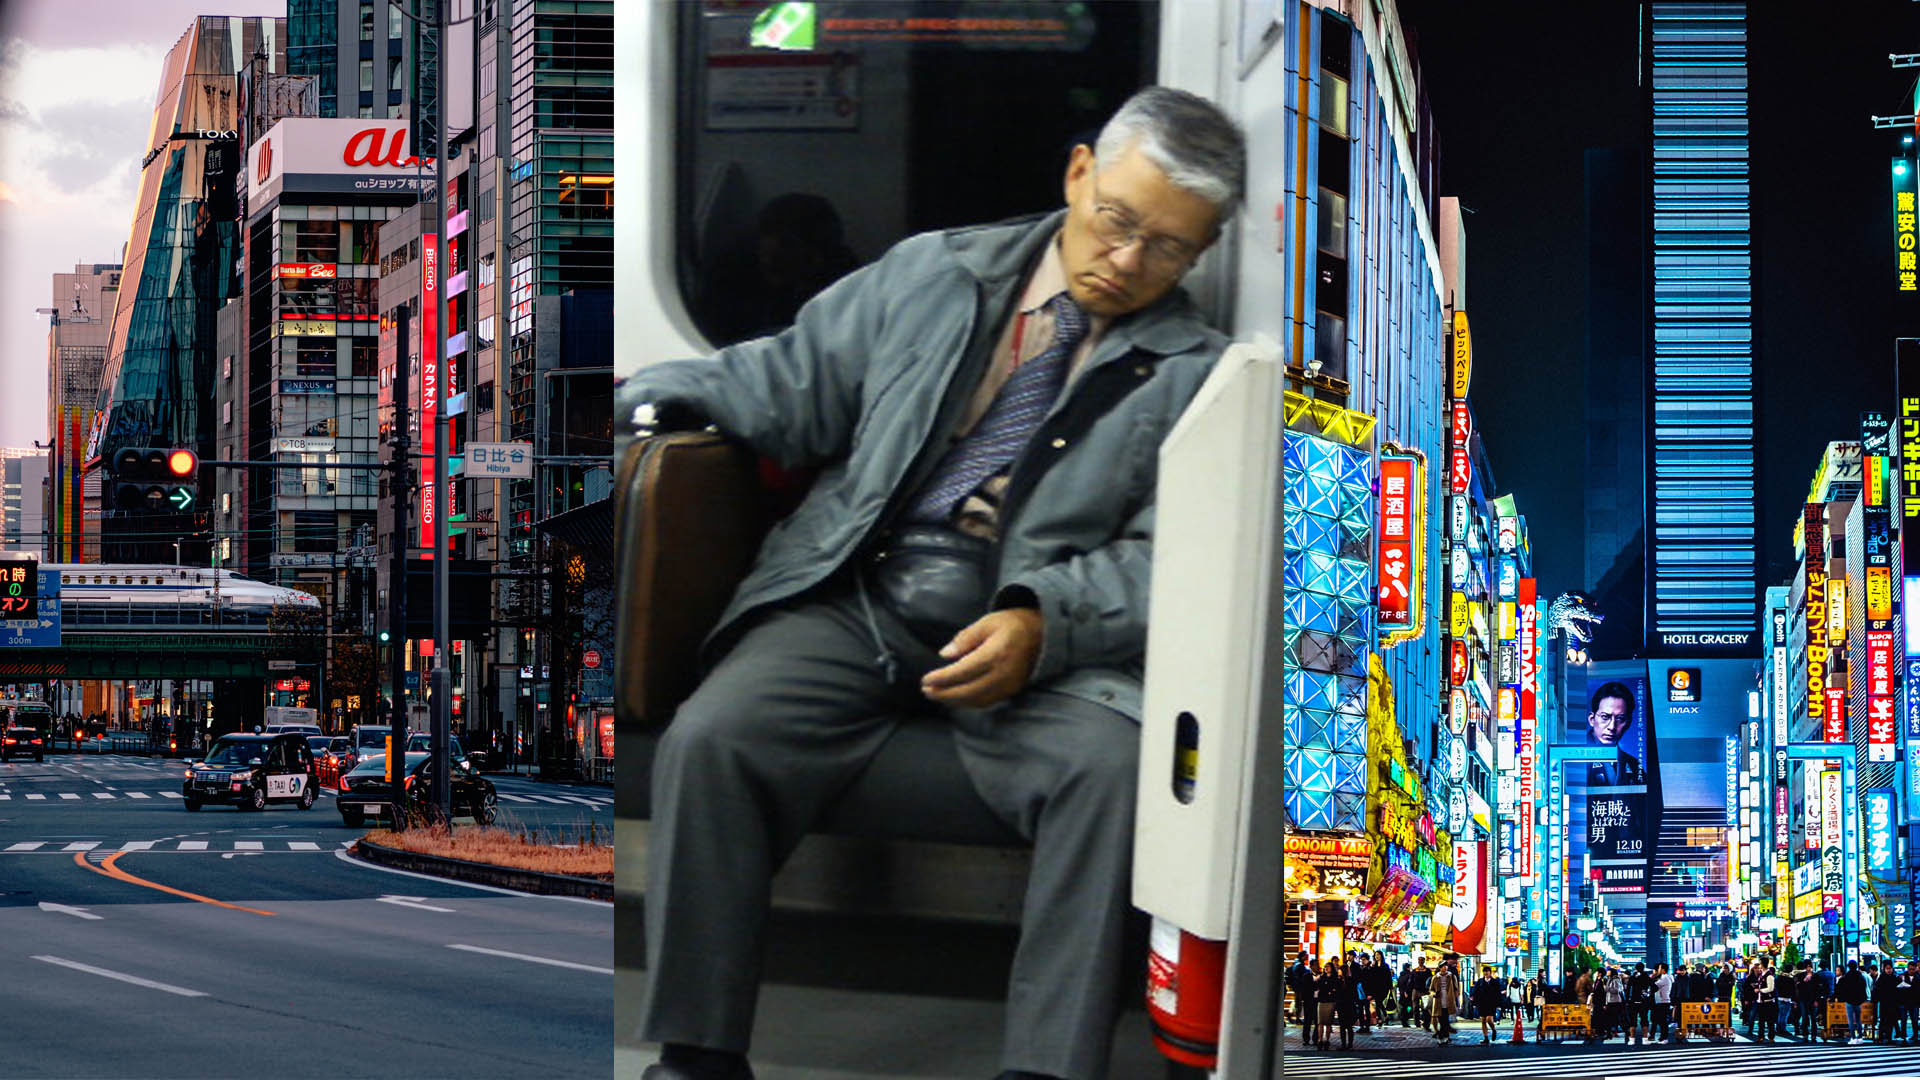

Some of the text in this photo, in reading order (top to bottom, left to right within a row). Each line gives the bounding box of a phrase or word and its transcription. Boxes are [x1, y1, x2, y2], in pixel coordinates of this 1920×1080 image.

[1897, 192, 1917, 291] 驚安の殿堂
[308, 264, 335, 277] Bee
[425, 265, 434, 291] ECHO
[293, 381, 320, 389] NEXUS
[424, 363, 436, 409] カラオケ
[289, 440, 305, 449] TCB
[473, 448, 525, 463] 日比谷
[486, 464, 511, 473] Hibiya
[423, 497, 433, 524] ECHO
[1385, 476, 1405, 536] 居酒屋
[9, 582, 21, 596] の
[2, 598, 29, 611] オン
[1872, 620, 1887, 630] 6F
[8, 637, 32, 645] 300m
[1663, 634, 1749, 644] HOTEL GRACERY
[1520, 603, 1536, 694] SHIDAX
[1520, 728, 1532, 797] BIC DRUG
[1591, 800, 1631, 817] 海賊と
[1591, 817, 1628, 827] よばれた
[1591, 827, 1606, 844] 男
[1870, 795, 1890, 868] カラオケ
[1339, 841, 1372, 855] YAKI
[1551, 775, 1560, 917] GODZILLA ROAD
[1616, 840, 1643, 850] 12.10
[1456, 846, 1467, 897] トラノコ
[1606, 869, 1644, 880] MARUHAN
[1823, 845, 1843, 893] 金の蔵
[1823, 896, 1839, 908] 2F
[1894, 904, 1908, 950] カラオケ
